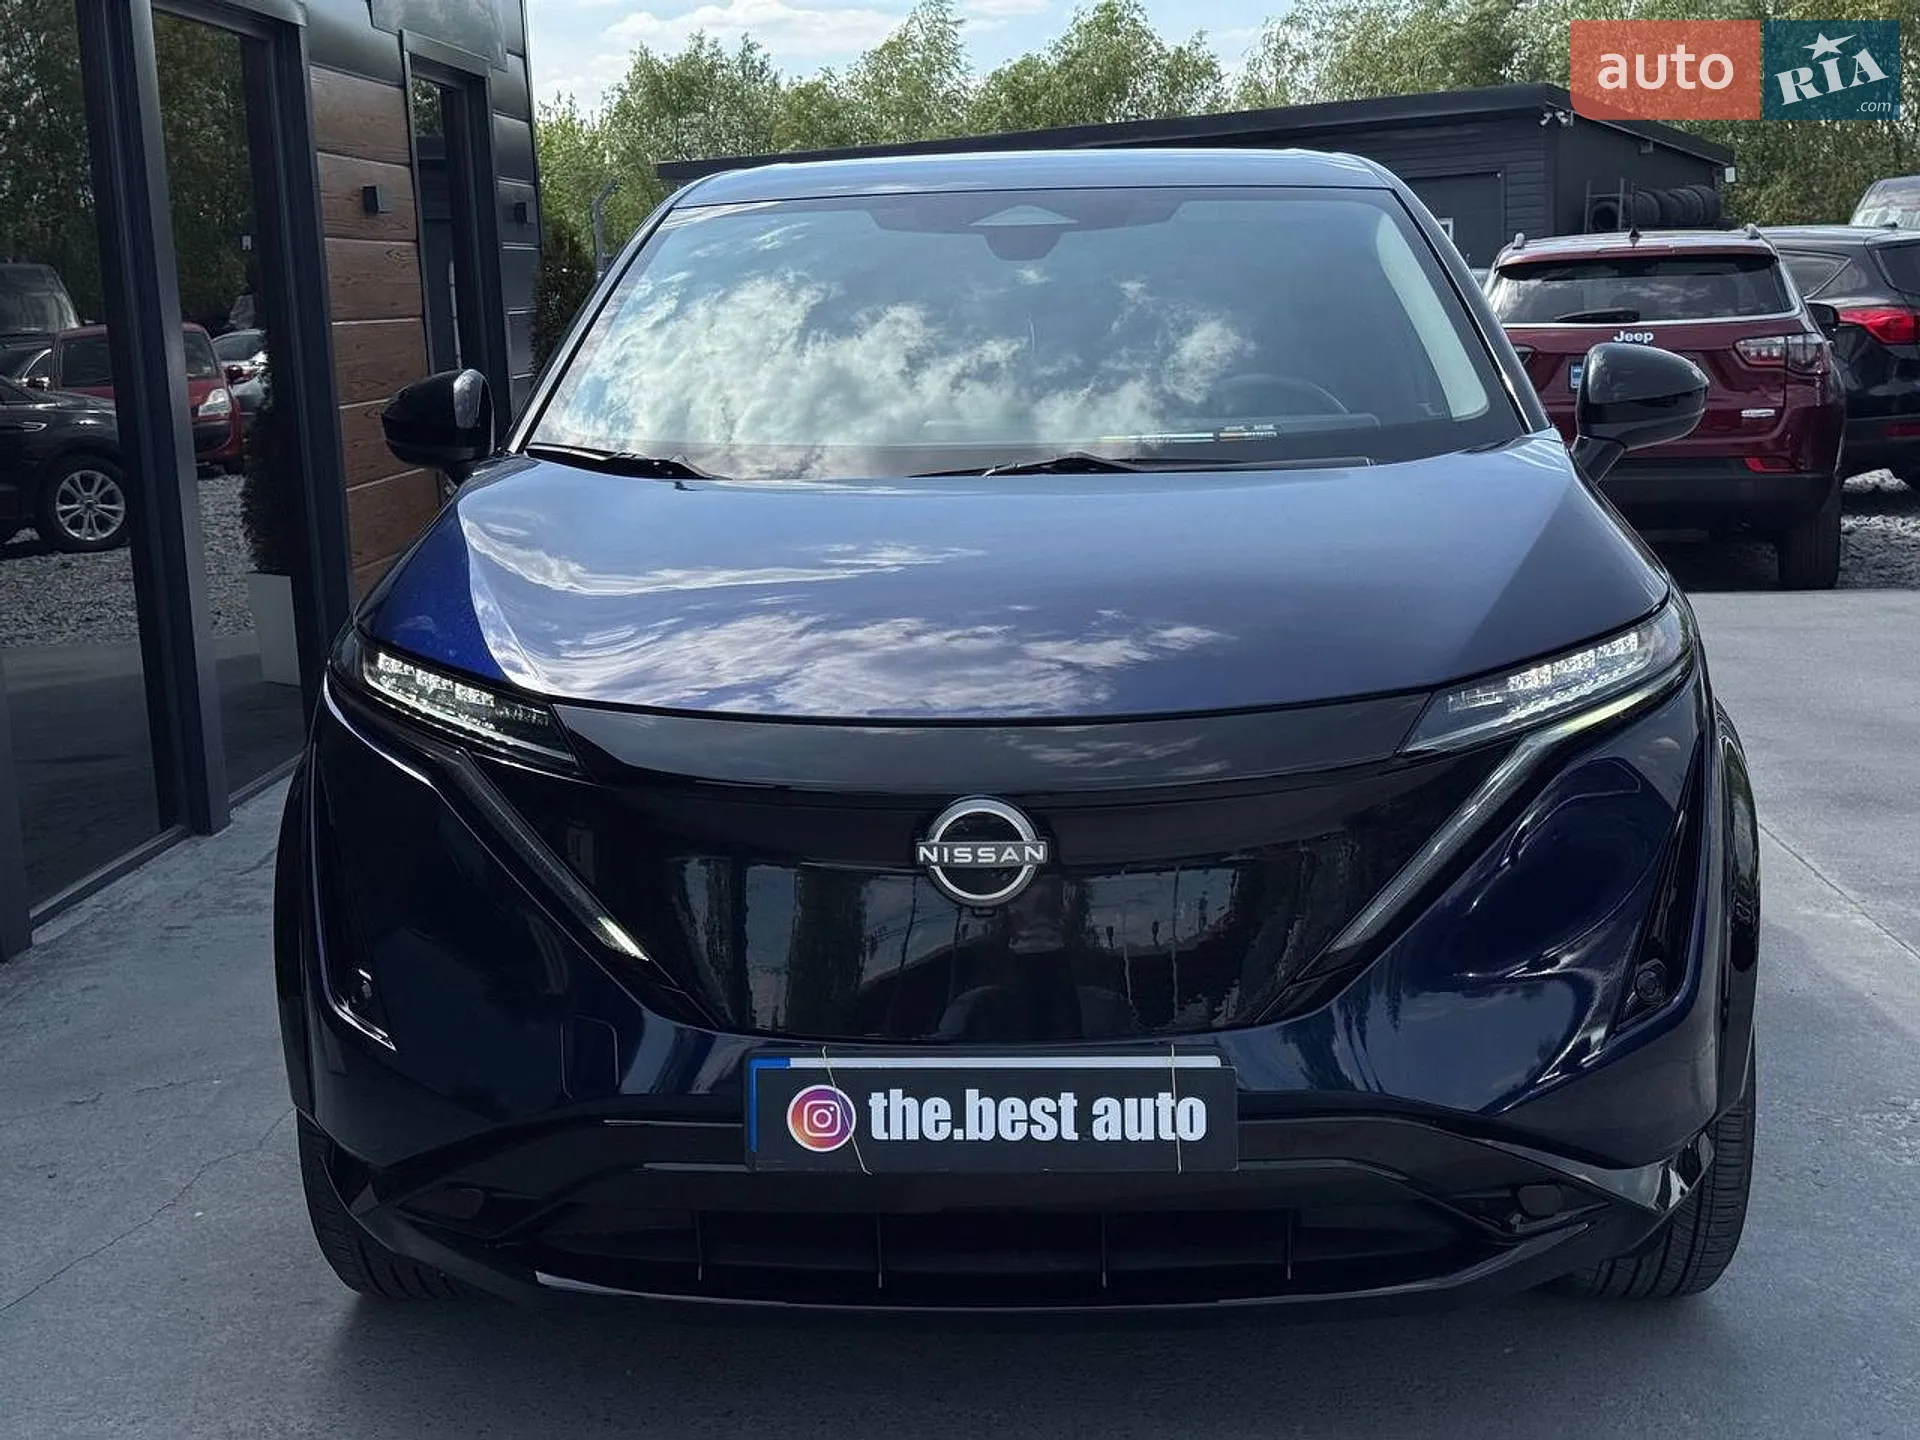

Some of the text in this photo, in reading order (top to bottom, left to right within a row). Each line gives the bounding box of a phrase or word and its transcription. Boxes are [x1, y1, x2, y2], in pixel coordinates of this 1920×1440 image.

[1613, 331, 1654, 344] Jeep
[919, 846, 1044, 863] NISSAN
[869, 1089, 1208, 1141] the.best auto
